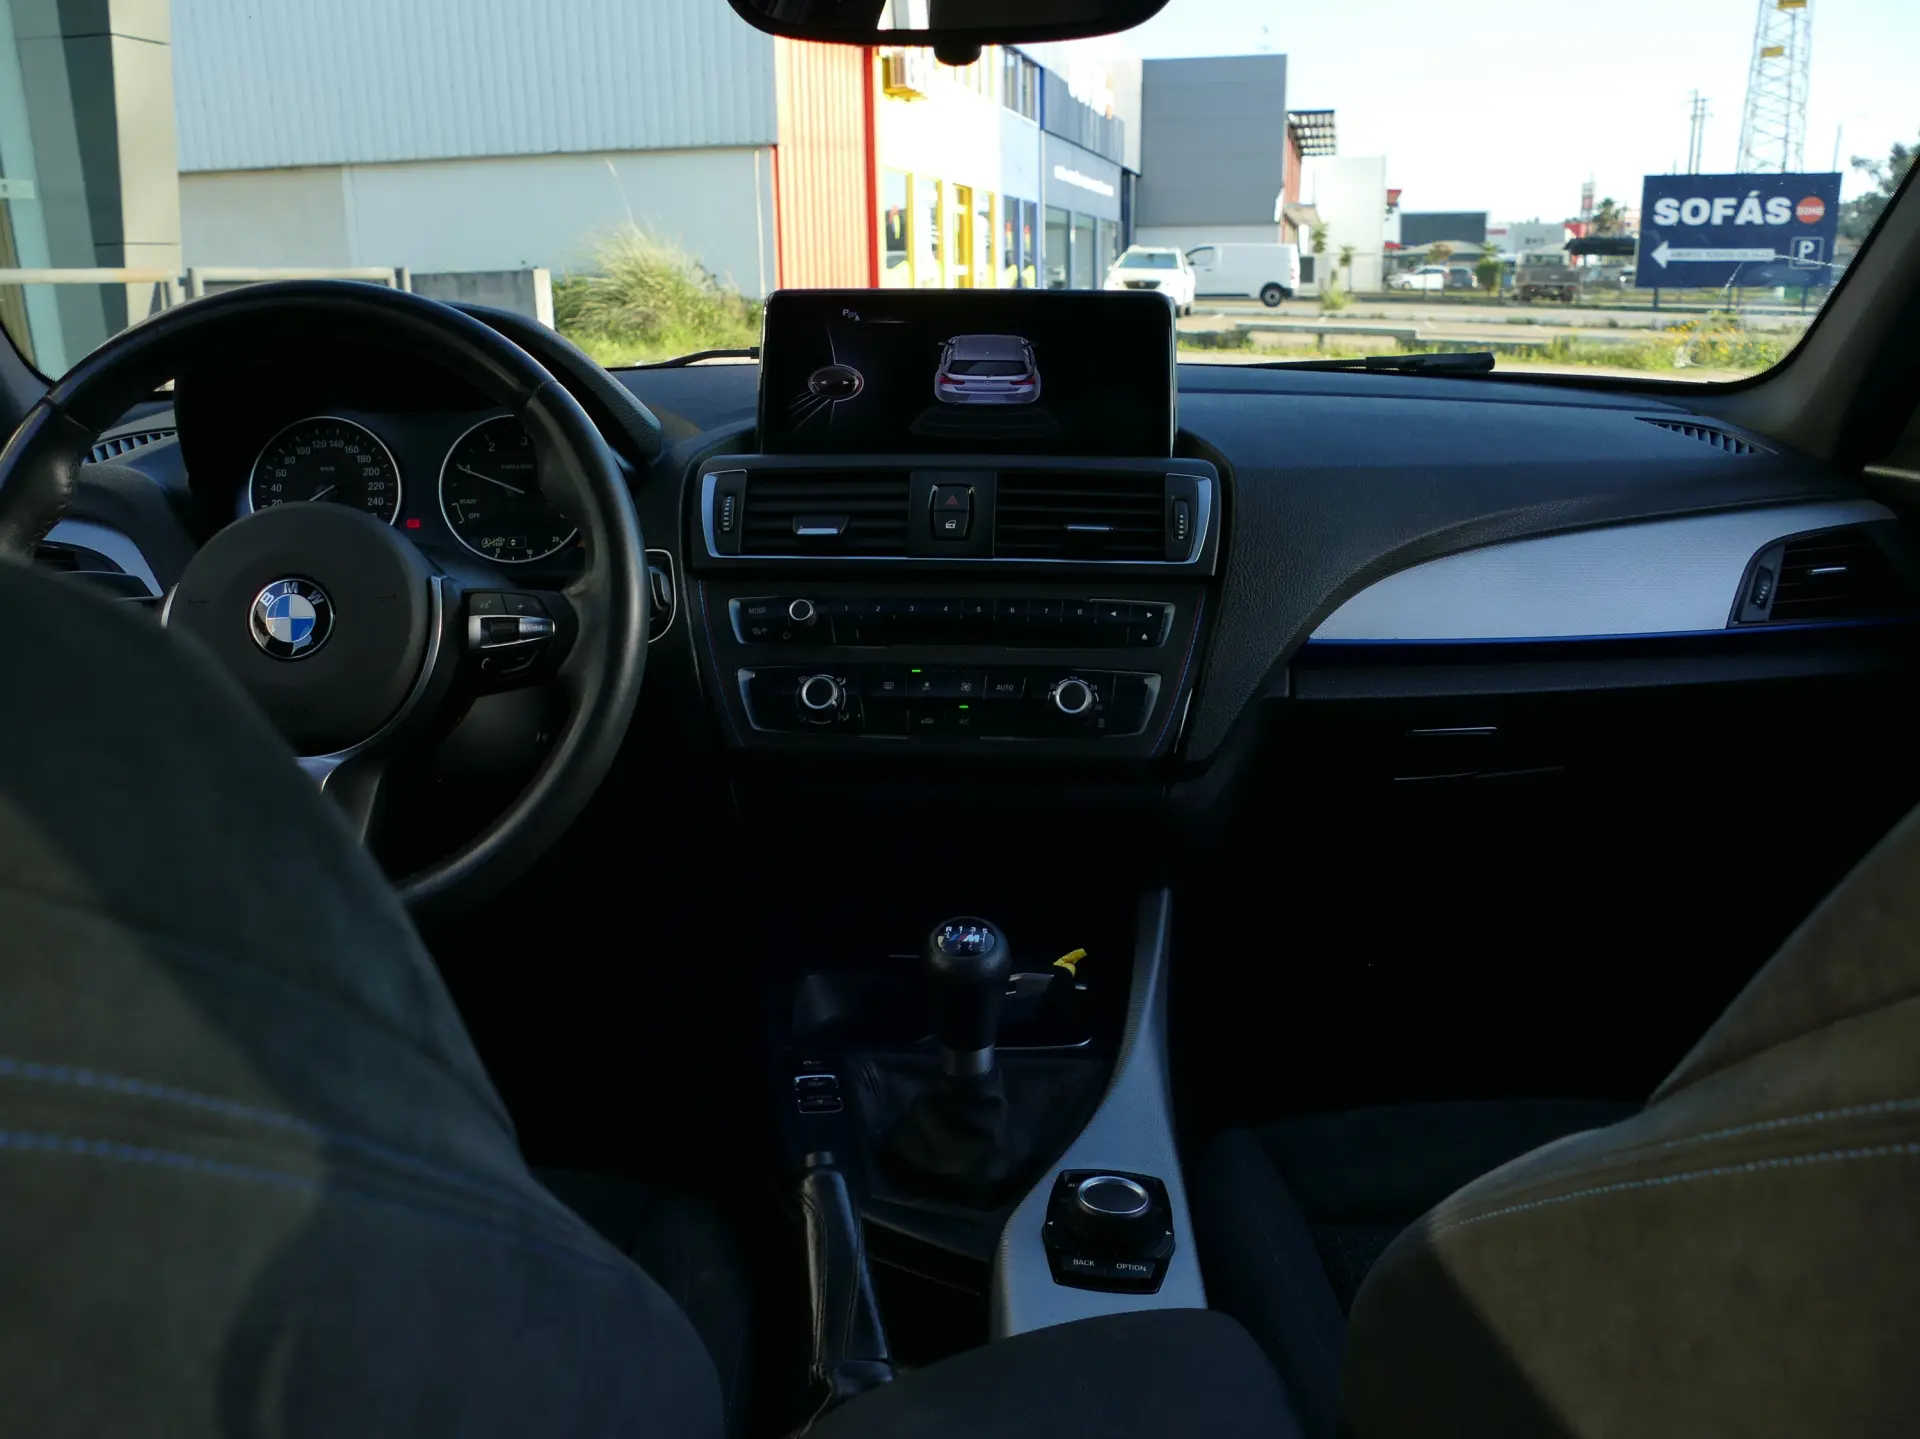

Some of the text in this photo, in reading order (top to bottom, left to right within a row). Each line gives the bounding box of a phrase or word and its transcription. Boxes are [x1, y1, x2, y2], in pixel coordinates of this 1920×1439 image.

[1652, 190, 1792, 226] SOFÁS
[1798, 240, 1815, 261] P
[312, 439, 344, 449] 120 140
[488, 442, 497, 452] 2
[275, 468, 287, 478] 60
[363, 467, 380, 477] 200
[270, 483, 282, 493] 40
[368, 482, 385, 491] 220
[367, 497, 384, 506] 240
[468, 512, 481, 520] OFF
[259, 580, 326, 608] BMW
[995, 683, 1014, 691] AUTO
[1073, 1258, 1095, 1267] BACK
[1116, 1262, 1147, 1272] OPTION
